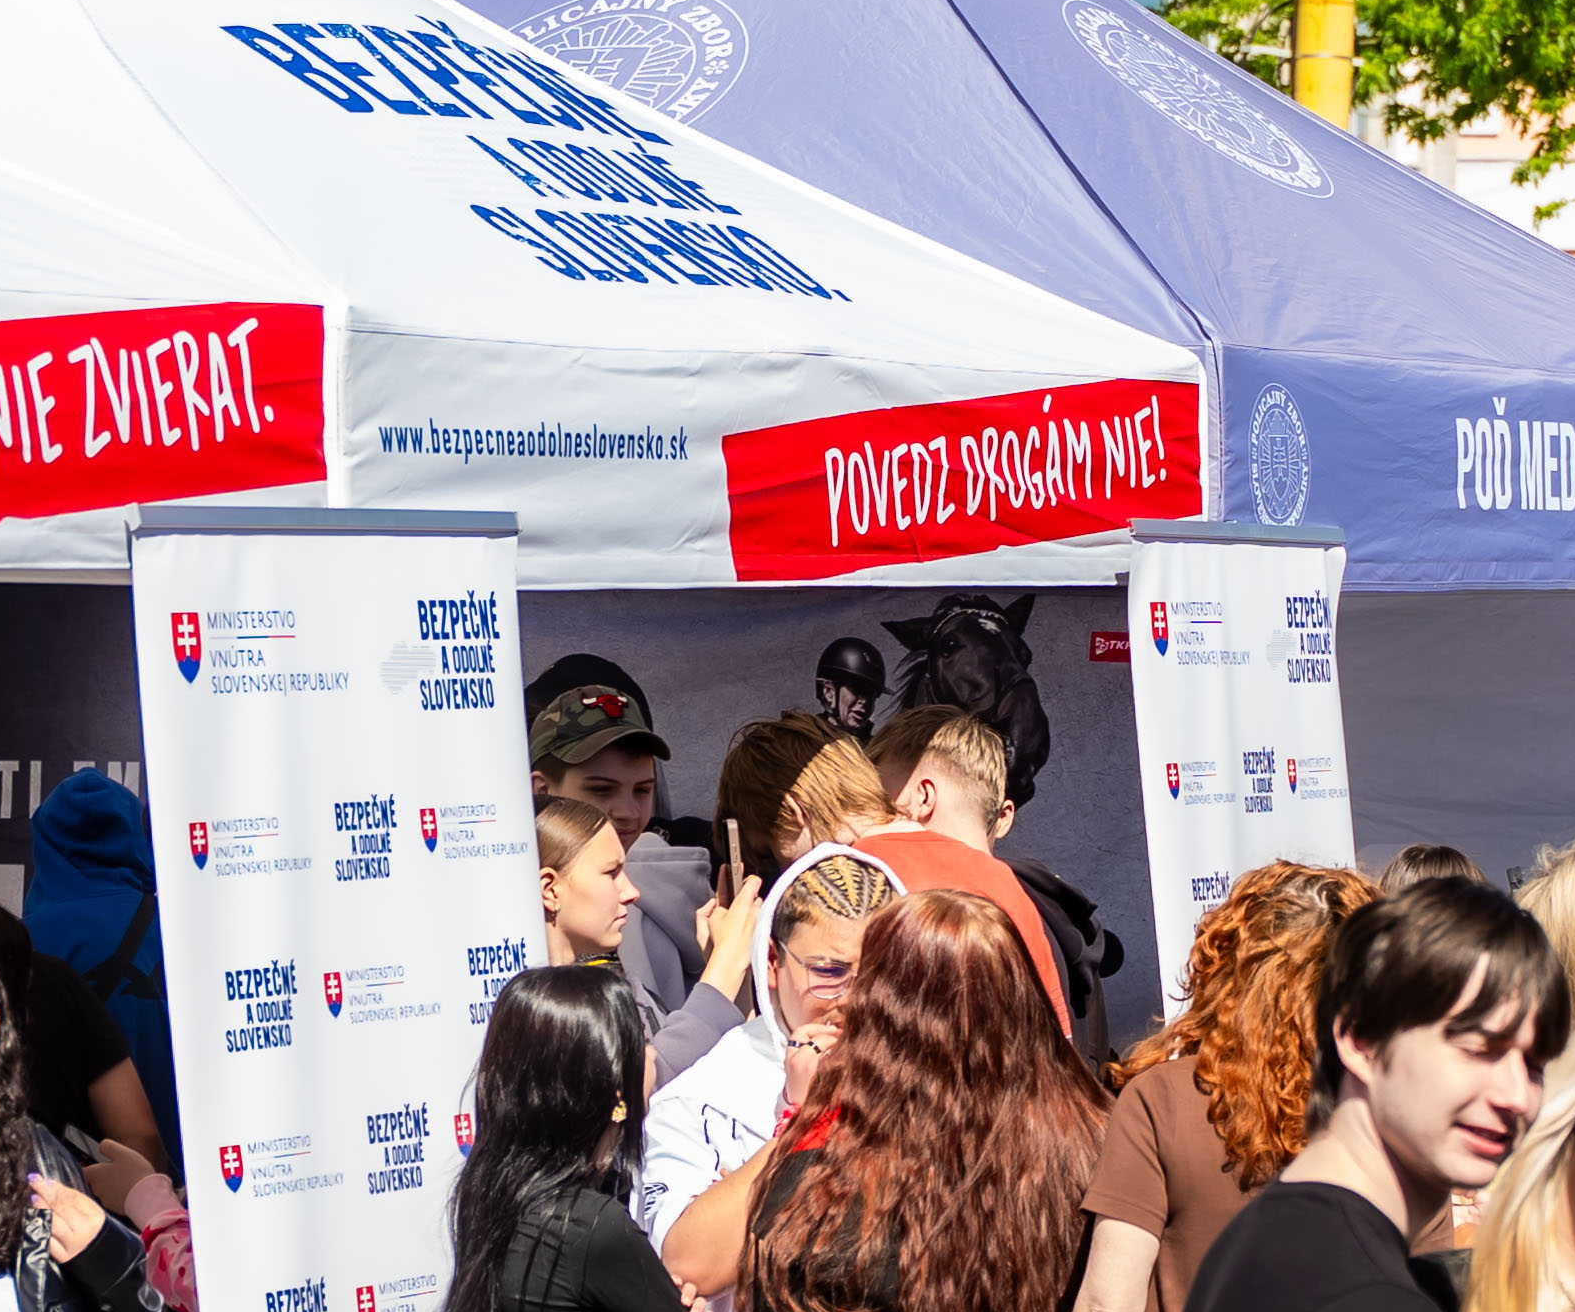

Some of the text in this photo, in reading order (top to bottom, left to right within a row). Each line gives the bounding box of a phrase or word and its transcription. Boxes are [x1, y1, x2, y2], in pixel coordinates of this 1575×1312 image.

[679, 4, 734, 62] ZBOR
[471, 204, 853, 303] SLOVENSKO.
[68, 317, 275, 460] ZVIERAT.
[379, 417, 690, 467] www.bezpecneaodolneslovensko.sk
[1455, 396, 1513, 511] POĎ
[825, 395, 1167, 548] POVEDZ DROGÁM NIE!
[207, 610, 295, 629] MINISTERSTVO
[417, 591, 500, 640] BEZPEČNÉ
[209, 646, 265, 668] VNÚTRA
[441, 640, 496, 674] A ODOLNÉ
[1287, 659, 1331, 684] SLOVENSKO
[212, 672, 349, 695] SLOVENSKEJ REPUBLIKY
[420, 677, 495, 710] SLOVENSKO
[334, 794, 397, 831] BEZPEČNÉ
[351, 829, 392, 855] A ODOLNÉ
[335, 856, 390, 882] SLOVENSKO
[225, 959, 297, 1001] BEZPEČNÉ
[247, 997, 293, 1025] A ODOLNÉ
[226, 1023, 292, 1053] SLOVENSKO
[367, 1102, 430, 1144] BEZPEČNÉ
[385, 1140, 424, 1168] A ODOLNÉ
[368, 1167, 423, 1195] SLOVENSKO
